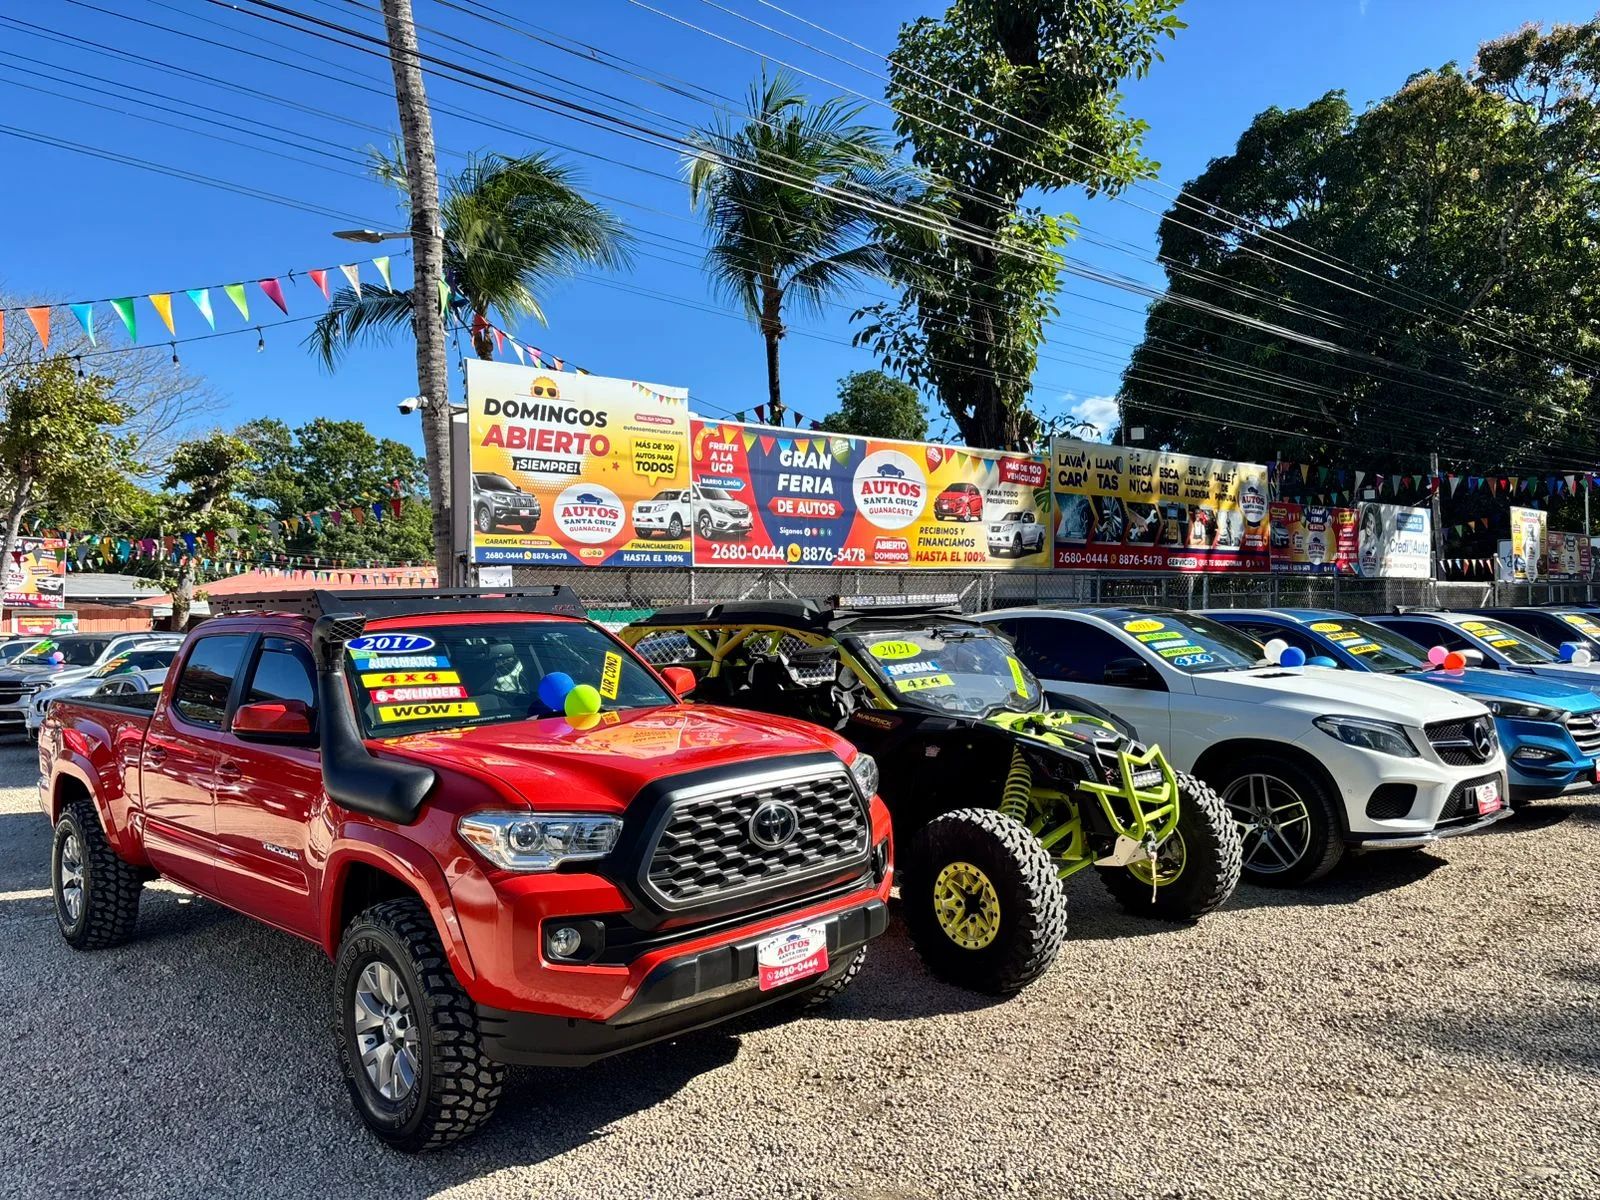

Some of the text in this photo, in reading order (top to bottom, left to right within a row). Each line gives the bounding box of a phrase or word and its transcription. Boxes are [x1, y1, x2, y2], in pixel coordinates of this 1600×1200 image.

[484, 398, 607, 428] DOMINGOS
[481, 424, 610, 457] ABIERTO
[635, 440, 651, 449] MÁS
[652, 442, 662, 450] DE
[709, 441, 738, 452] FRENTE
[635, 452, 674, 461] AUTOS PARA
[710, 451, 733, 462] A LA
[779, 450, 832, 470] GRAN
[1058, 453, 1082, 468] LAVA
[516, 458, 579, 473] ¡SIEMPRE!
[635, 460, 674, 474] TODOS
[711, 462, 734, 474] UCR
[1020, 464, 1028, 472] DE
[1029, 465, 1042, 475] 100
[1129, 463, 1153, 477] MECÁ
[1188, 465, 1197, 476] SE
[1006, 472, 1041, 483] VEHÍCULOS!
[1058, 470, 1083, 488] CAR
[1159, 466, 1180, 480] ESCA
[702, 478, 722, 486] BARRIO
[777, 473, 834, 494] FERIA
[1097, 473, 1119, 491] TAS
[1184, 478, 1210, 488] LLEVAMOS
[861, 481, 921, 498] AUTOS
[1003, 490, 1019, 498] TODO
[1159, 482, 1179, 497] NER
[1185, 488, 1190, 497] A
[863, 496, 919, 507] SANTA CRUZ
[986, 497, 1019, 505] PRESUPUESTO
[1241, 496, 1265, 505] AUTOS
[561, 506, 619, 520] AUTOS
[777, 500, 836, 516] DE AUTOS
[868, 507, 914, 517] GUANACASTE
[1311, 507, 1323, 515] GRAN
[564, 518, 617, 527] SANTA CRUZ
[569, 526, 612, 534] GUANACASTE
[779, 526, 803, 536] Síganos
[919, 526, 965, 536] RECIBIMOS Y
[631, 542, 684, 550] FINANCIAMIENTO
[875, 540, 907, 550] ABIERTO
[917, 537, 976, 548] FINANCIAMOS
[485, 551, 523, 560] 2680-0444
[532, 552, 568, 560] 8876-5478
[623, 553, 684, 562] HASTA EL 100%
[711, 543, 785, 560] 2680-0444
[803, 546, 866, 562] 8876-5478
[874, 551, 909, 561] DOMINGOS
[915, 550, 986, 562] HASTA EL 100%
[1059, 551, 1108, 564] 2680-0444
[1118, 554, 1163, 566] 8876-5478
[1168, 558, 1196, 566] SERVICIOS
[362, 636, 418, 649] 2017
[881, 643, 911, 656] 2021
[368, 655, 438, 669] AUTOMATIC
[604, 655, 618, 679] COND
[888, 661, 938, 676] SPECIAL
[601, 678, 615, 696] AIR
[375, 686, 461, 702] 6-CYLINDER
[392, 704, 451, 717] WOW
[856, 712, 893, 728] MAVERICK
[777, 938, 810, 956] AUTOS
[779, 951, 796, 960] SANTA
[774, 957, 819, 980] 2680-0444
